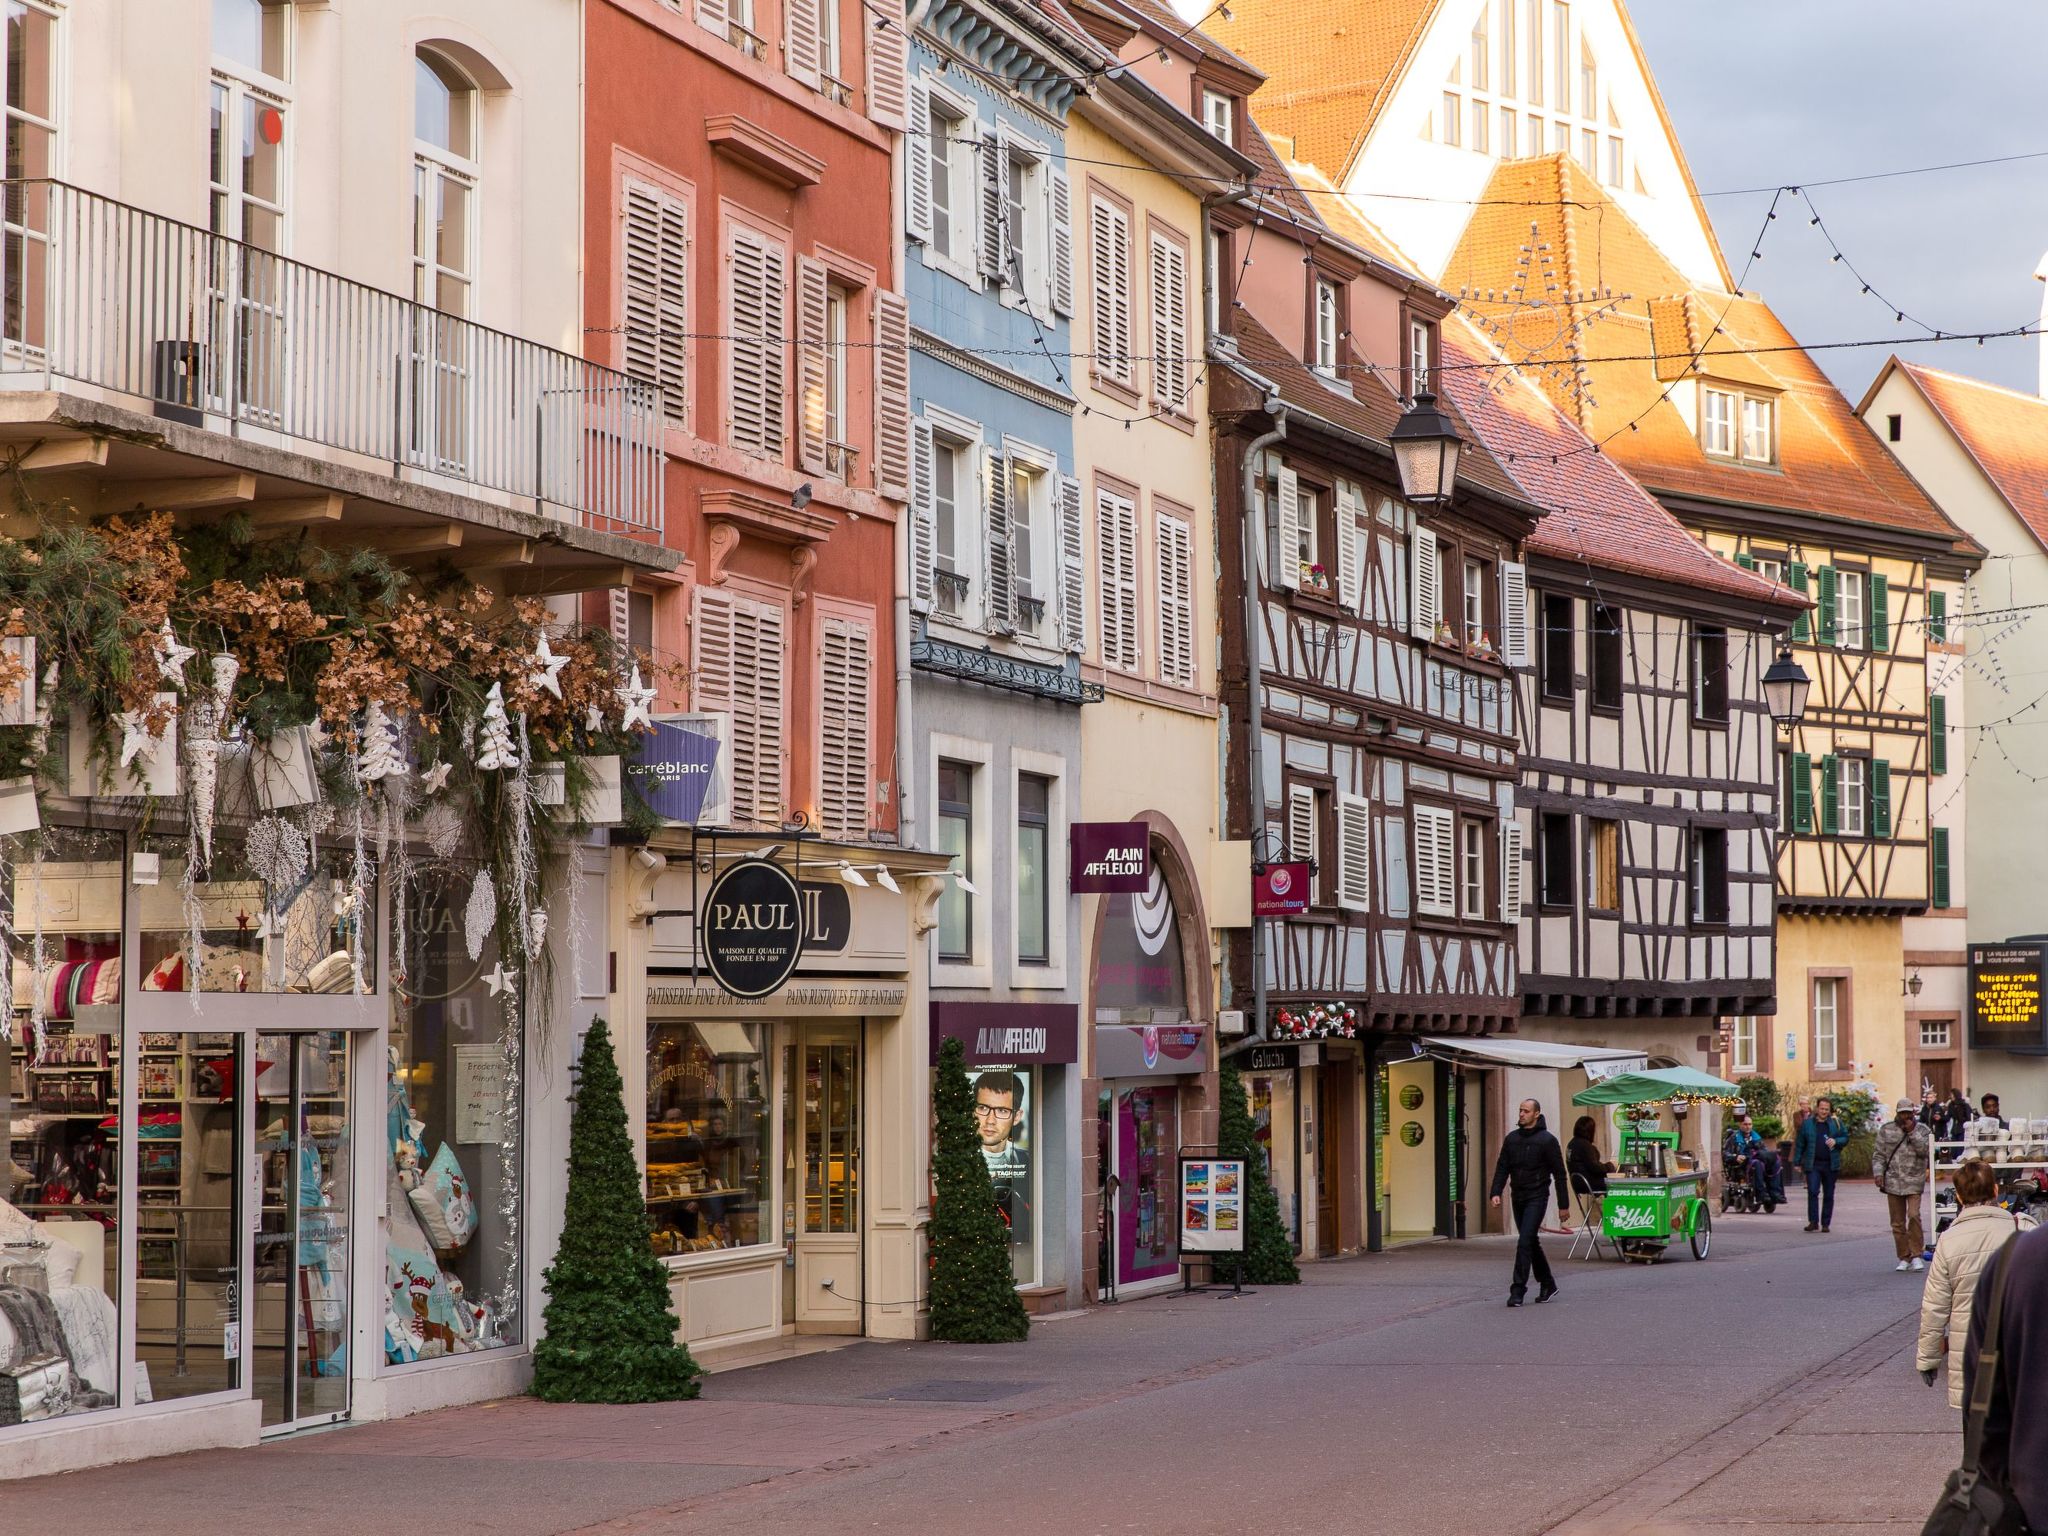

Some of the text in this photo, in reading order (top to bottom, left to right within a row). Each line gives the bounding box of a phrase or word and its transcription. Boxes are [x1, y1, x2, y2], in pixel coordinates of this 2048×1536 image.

[628, 762, 709, 774] carréblanc
[1104, 848, 1143, 861] ALAIN
[1083, 862, 1143, 875] AFFLELOU
[1258, 900, 1304, 908] nationaltours
[714, 904, 795, 930] PAUL
[718, 947, 745, 955] MAISON
[758, 947, 787, 955] QUALITE
[646, 987, 693, 1005] PATISSERIE
[694, 988, 716, 1005] FINE
[717, 988, 733, 1005] PUR
[786, 989, 904, 1008] PAINS RUSTIQUES ET DE FANTAISIE
